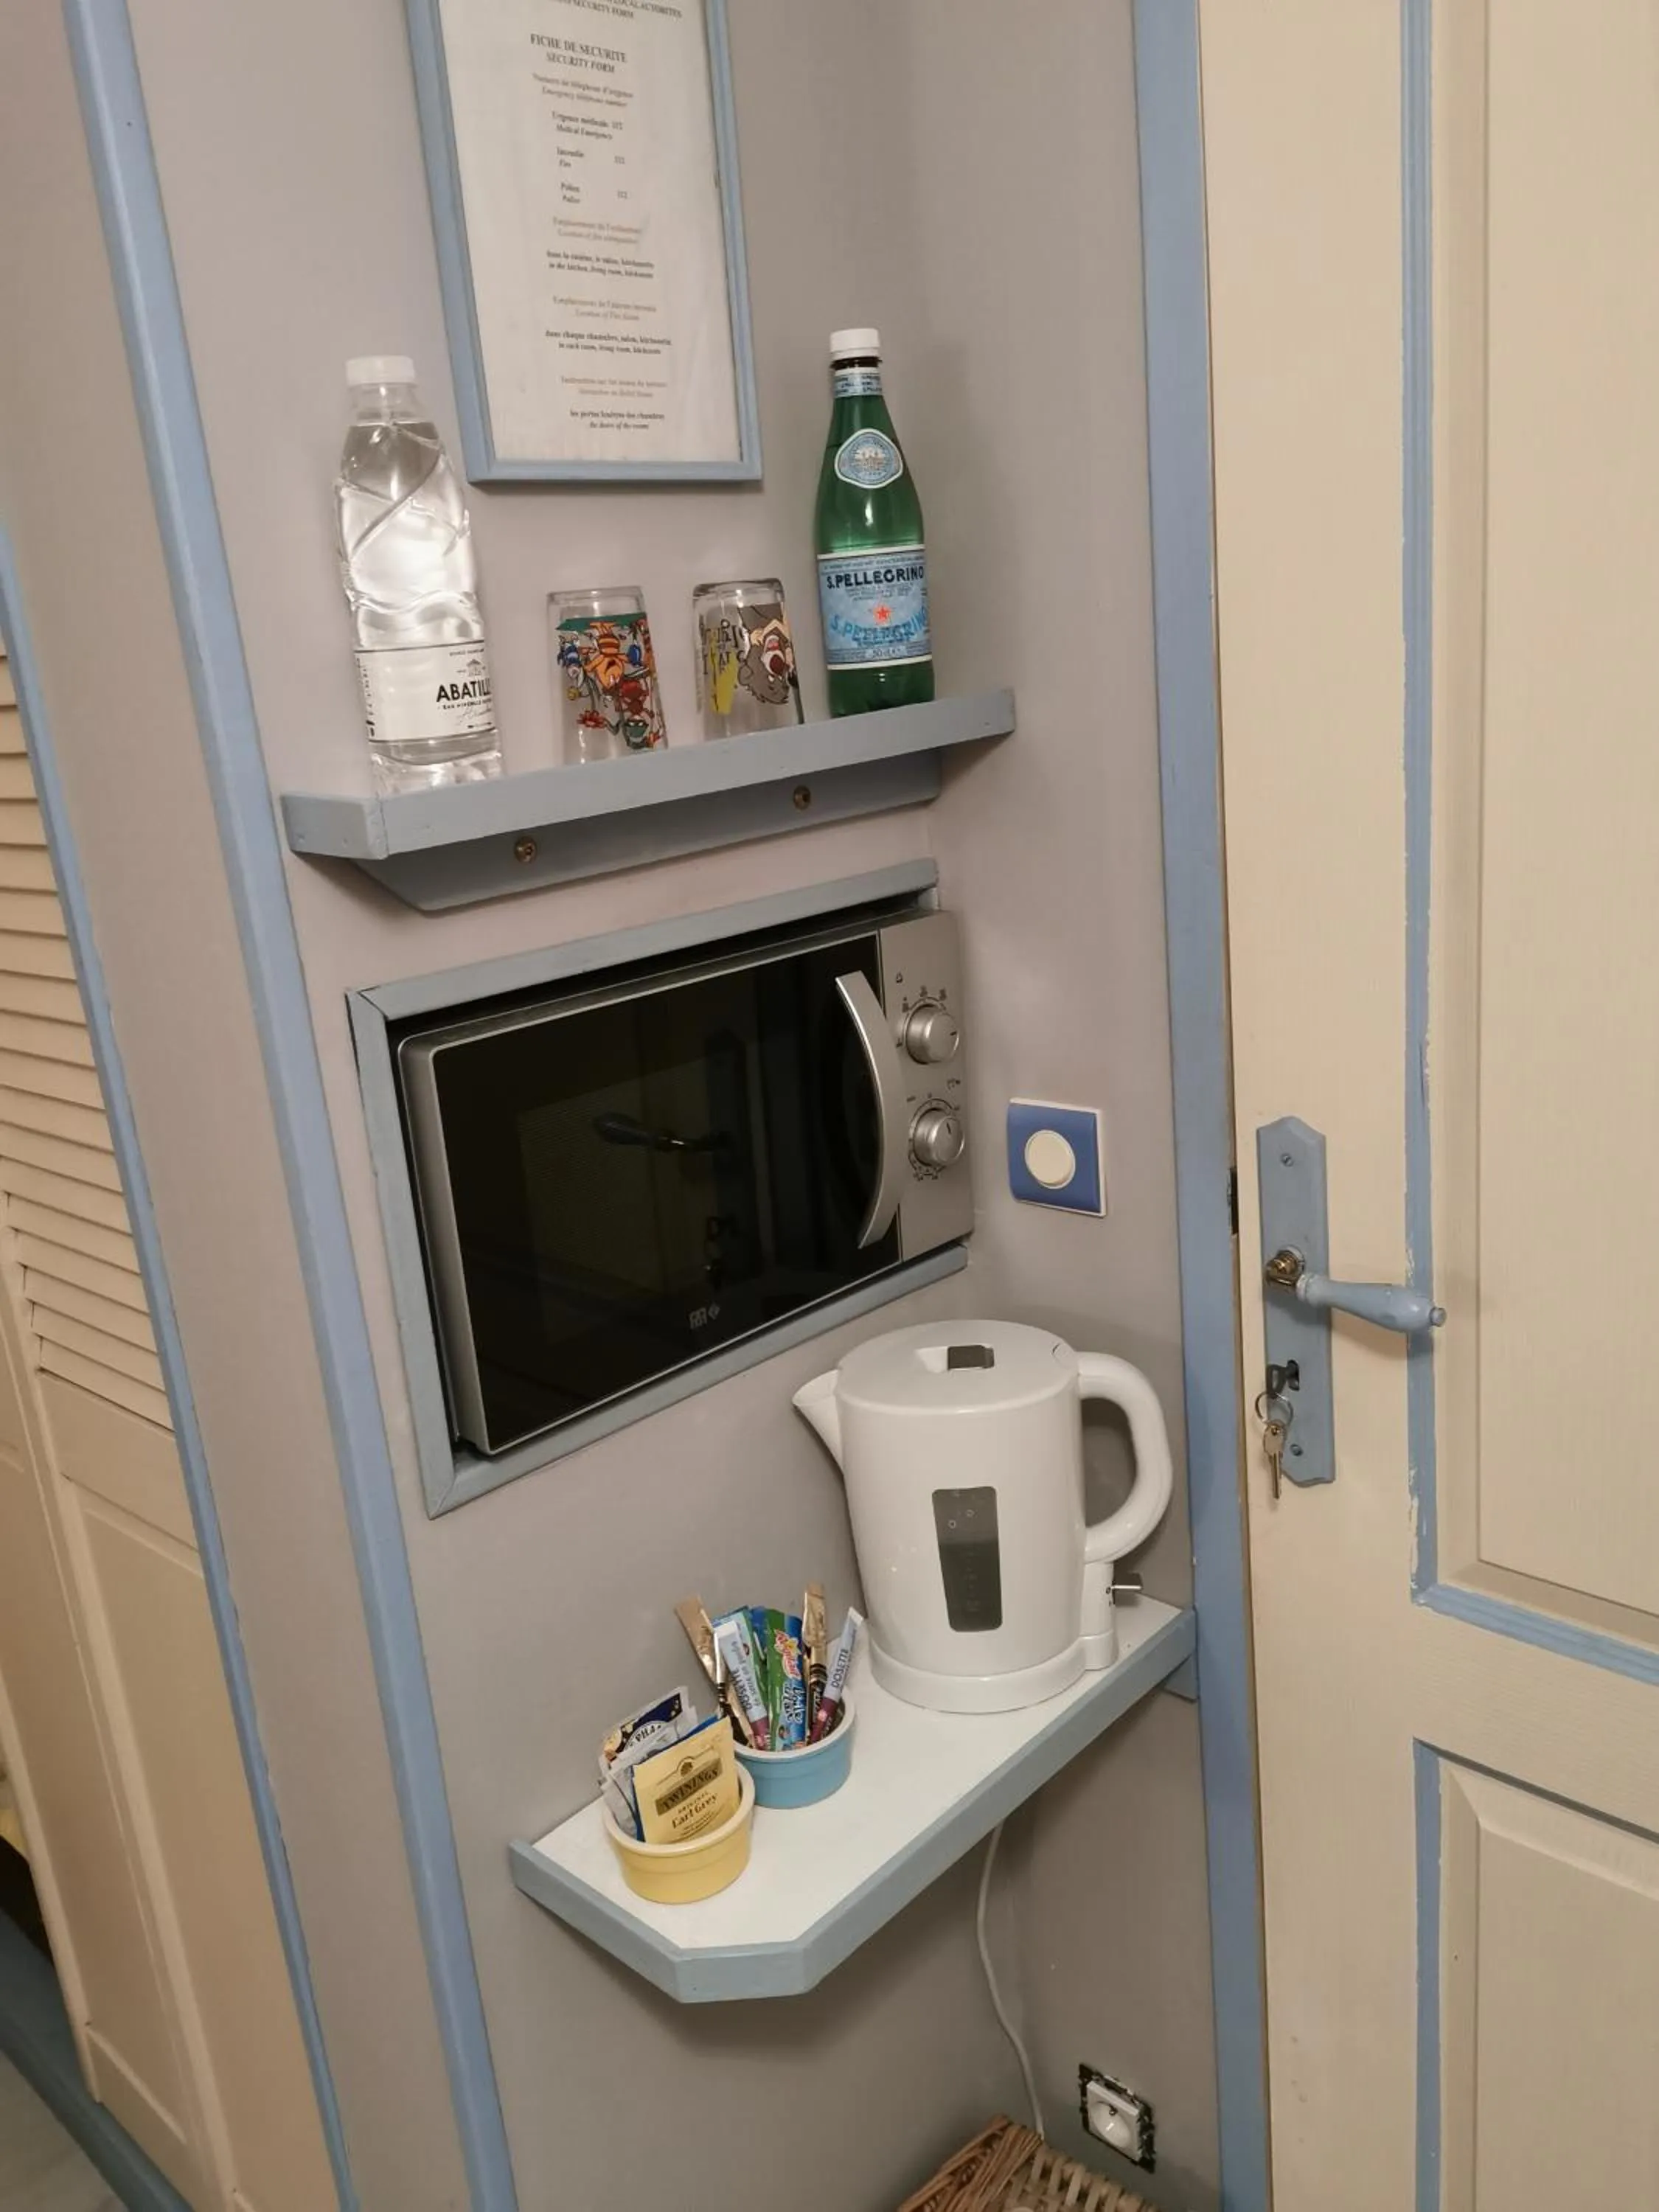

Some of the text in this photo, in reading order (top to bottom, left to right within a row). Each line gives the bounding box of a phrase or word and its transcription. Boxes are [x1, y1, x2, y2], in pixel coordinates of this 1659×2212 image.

[530, 33, 627, 63] FICHE DE SECURITE
[546, 52, 616, 74] SECURITY FORM
[826, 565, 925, 589] S.PELLEGRINO
[661, 1767, 720, 1812] TWININGS
[672, 1808, 695, 1829] Earl
[693, 1792, 718, 1815] Grey
